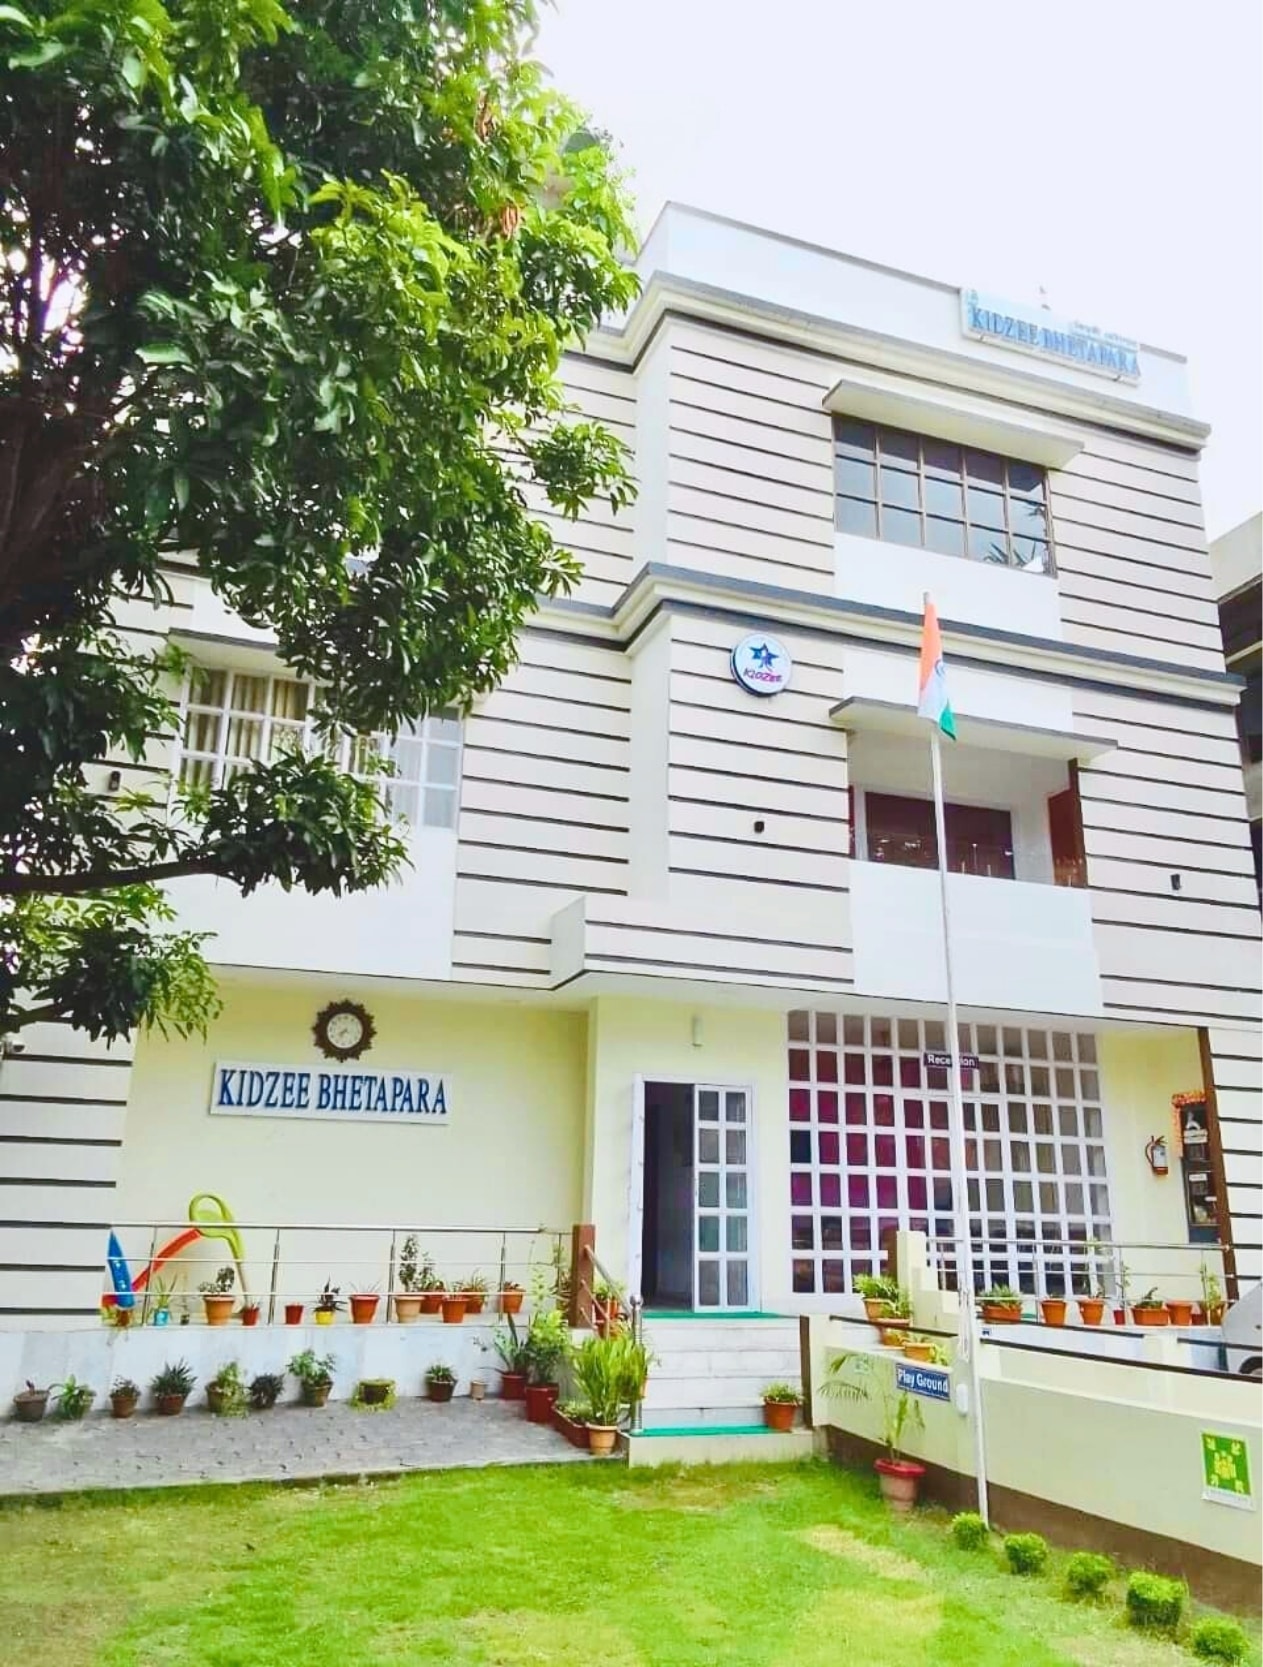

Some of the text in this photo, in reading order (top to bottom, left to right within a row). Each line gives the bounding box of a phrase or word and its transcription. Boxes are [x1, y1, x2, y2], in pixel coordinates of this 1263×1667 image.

[971, 307, 1039, 346] KIDZEE
[1042, 328, 1141, 377] BHETAPARA
[218, 1068, 447, 1115] KIDZEE BHETAPARA
[897, 1369, 948, 1393] Play Ground
